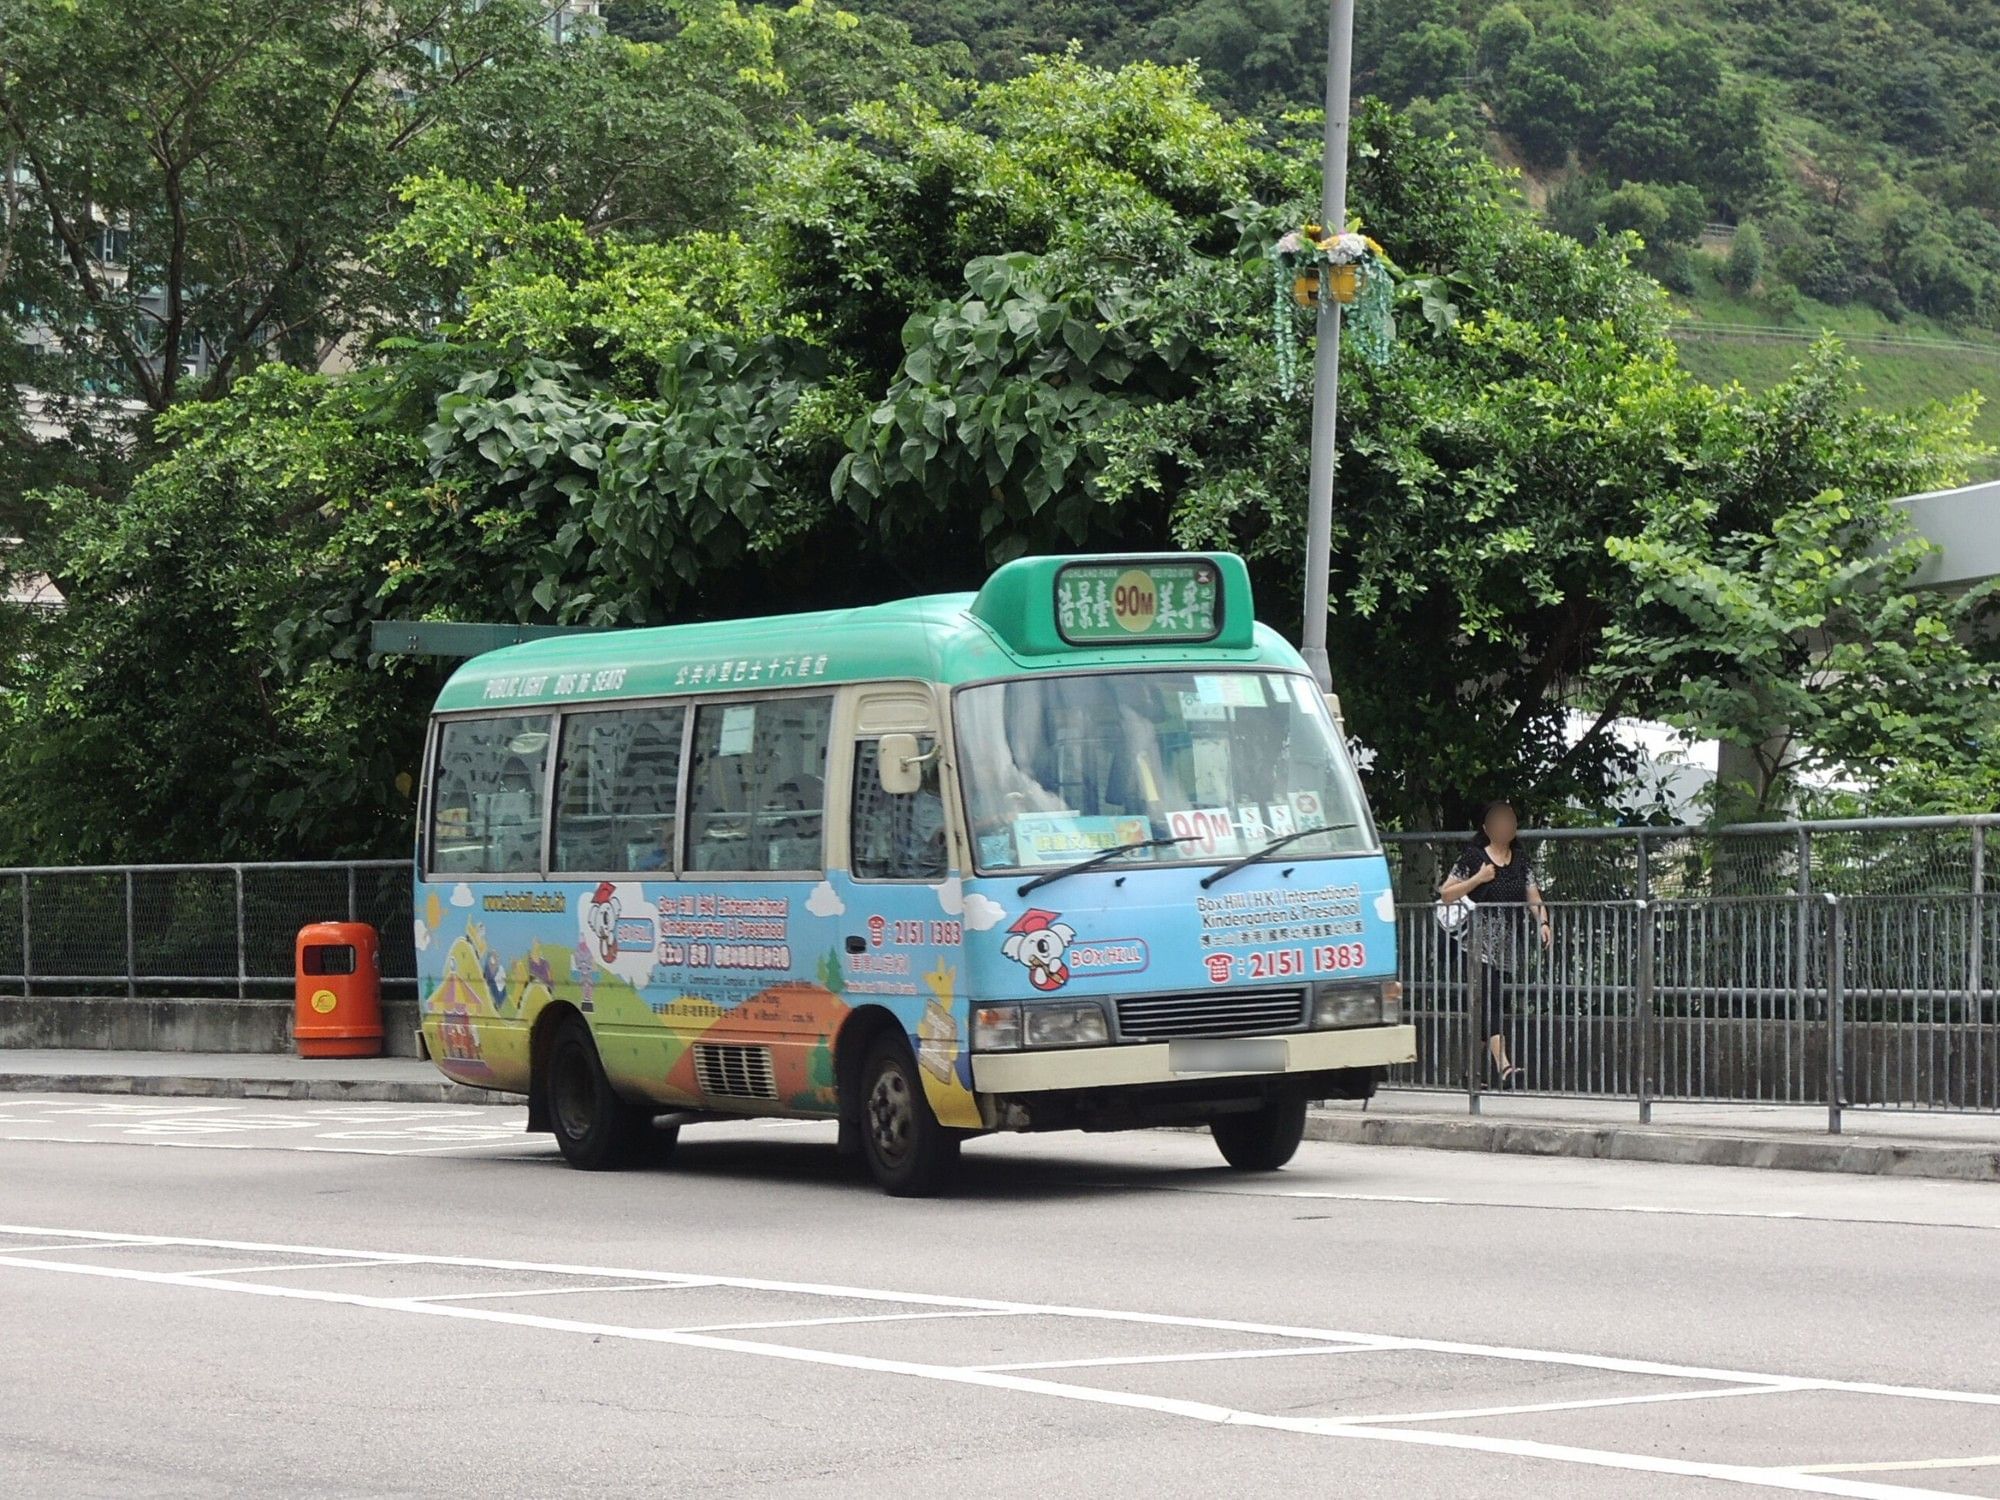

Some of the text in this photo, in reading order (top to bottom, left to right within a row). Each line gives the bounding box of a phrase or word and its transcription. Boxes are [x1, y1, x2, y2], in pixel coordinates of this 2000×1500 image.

[1114, 585, 1154, 617] 90M
[483, 677, 520, 699] PUBLIC
[517, 675, 549, 697] LIGHT
[553, 673, 577, 695] BUS
[591, 668, 627, 692] SEATS
[1172, 811, 1232, 856] 90M
[717, 894, 788, 918] International
[1198, 897, 1223, 912] Box
[1225, 894, 1246, 909] Hill
[1283, 884, 1360, 905] International
[660, 918, 726, 941] Kindergarten
[735, 919, 786, 940] Preschool
[1202, 902, 1360, 929] Kindergarten & Preschool
[896, 919, 963, 946] 2151 1383
[1250, 943, 1366, 979] 2151 1383
